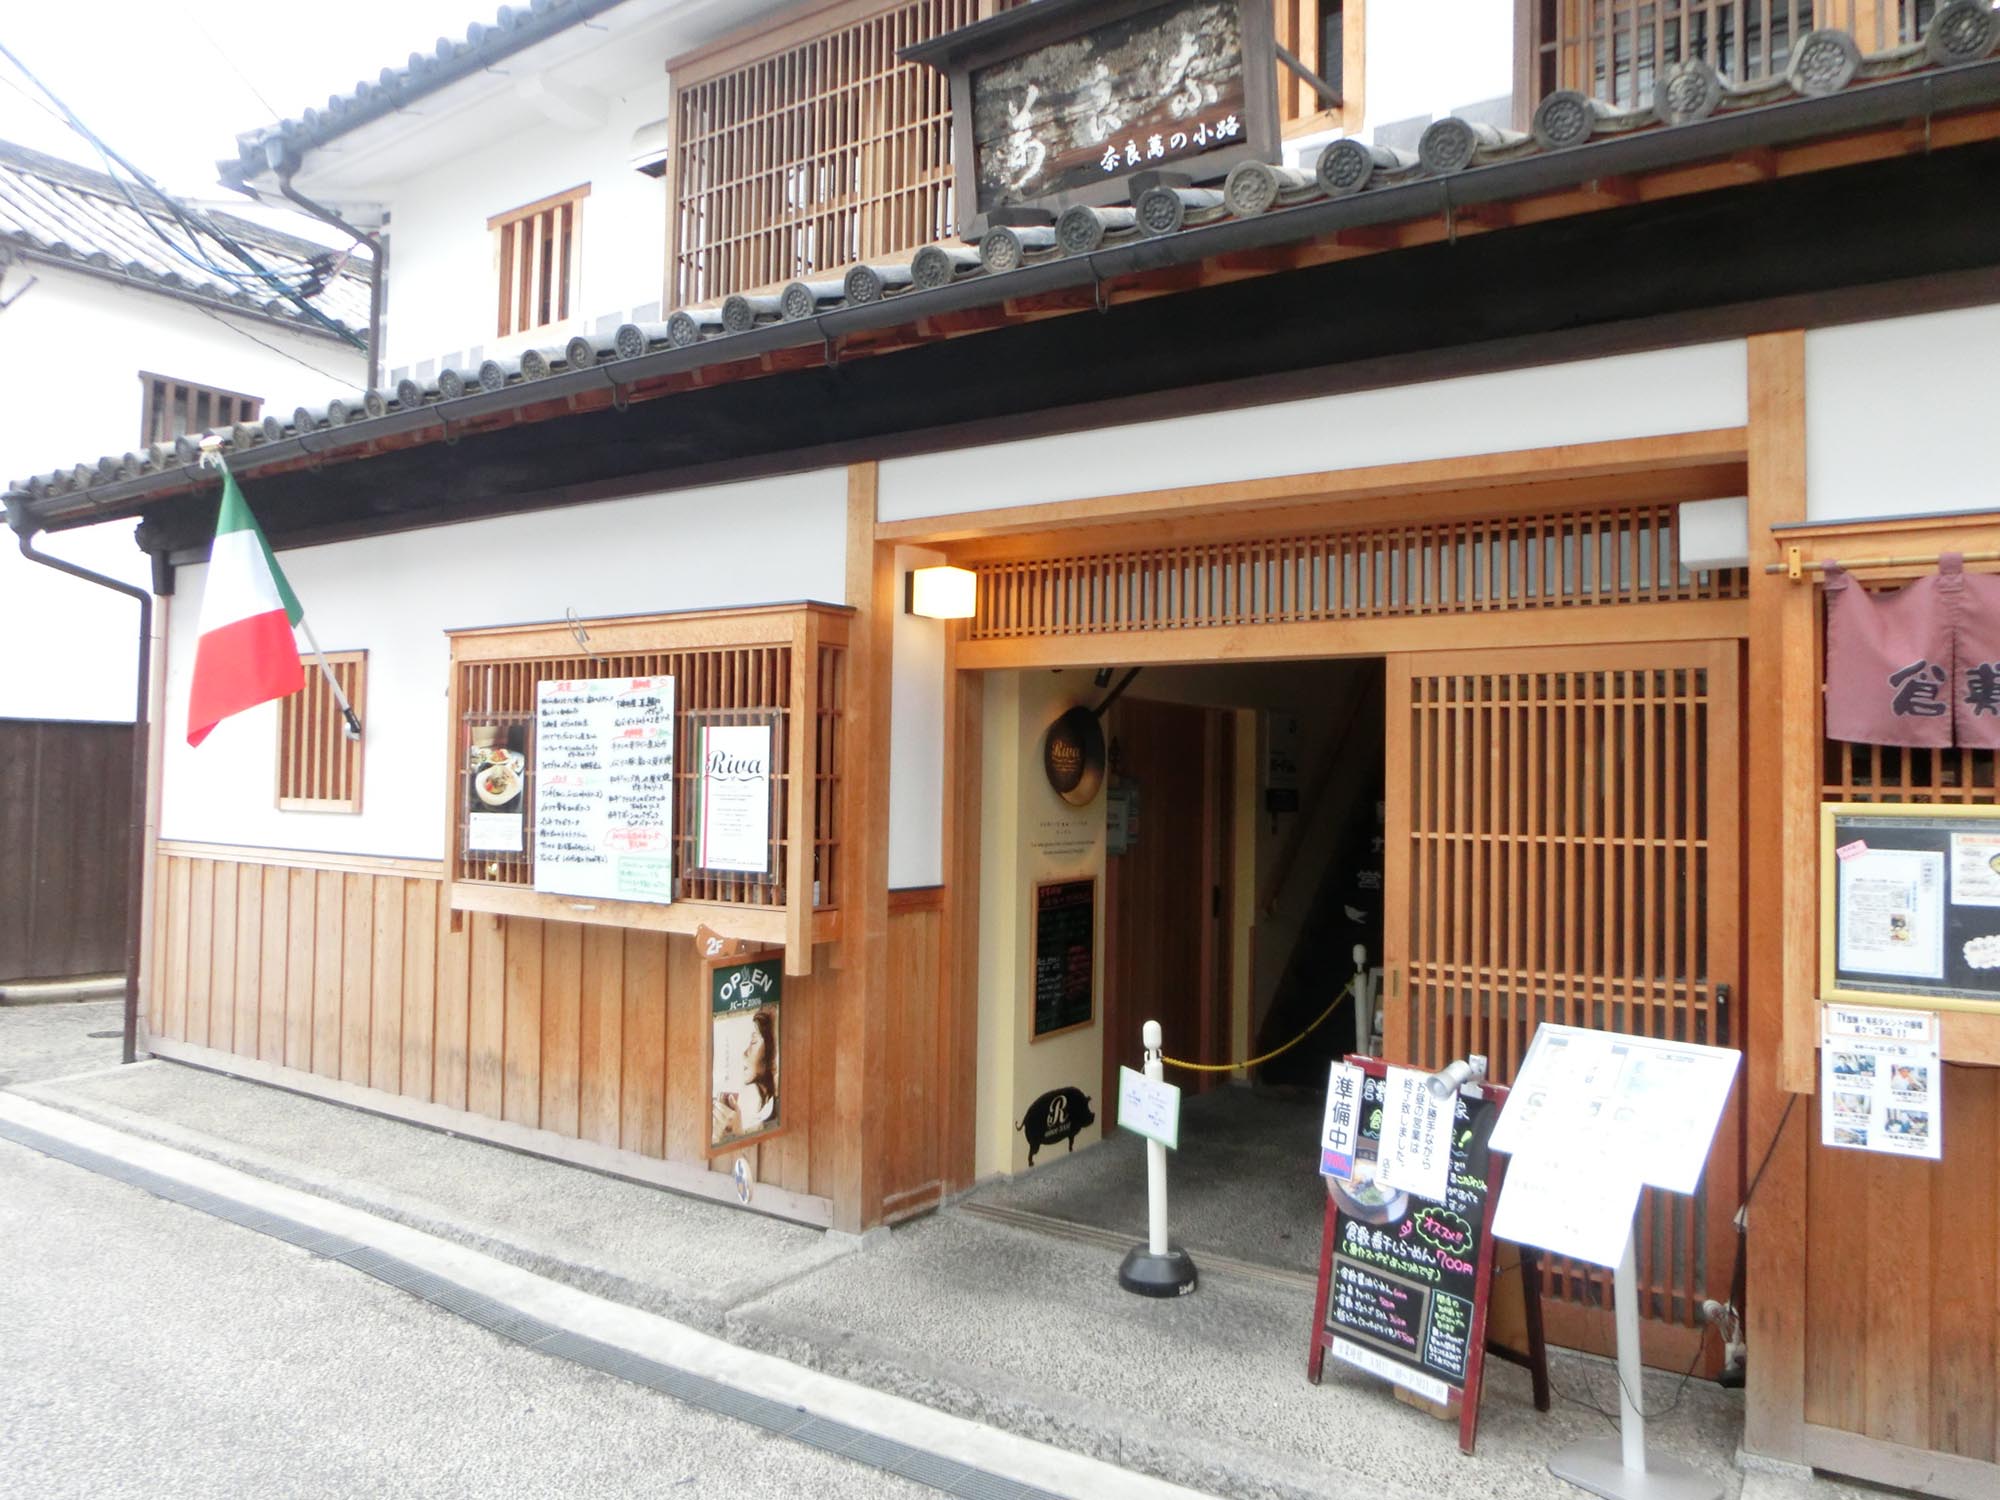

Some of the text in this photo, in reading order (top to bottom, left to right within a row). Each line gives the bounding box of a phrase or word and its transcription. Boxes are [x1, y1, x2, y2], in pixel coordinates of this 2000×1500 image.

[1100, 114, 1241, 173] 奈良萬の小路
[707, 750, 762, 774] Riva
[706, 936, 724, 956] 2F
[720, 968, 773, 1000] OPEN
[1047, 1095, 1068, 1127] R
[1329, 1075, 1355, 1150] 準備中
[1436, 1249, 1474, 1276] 700円
